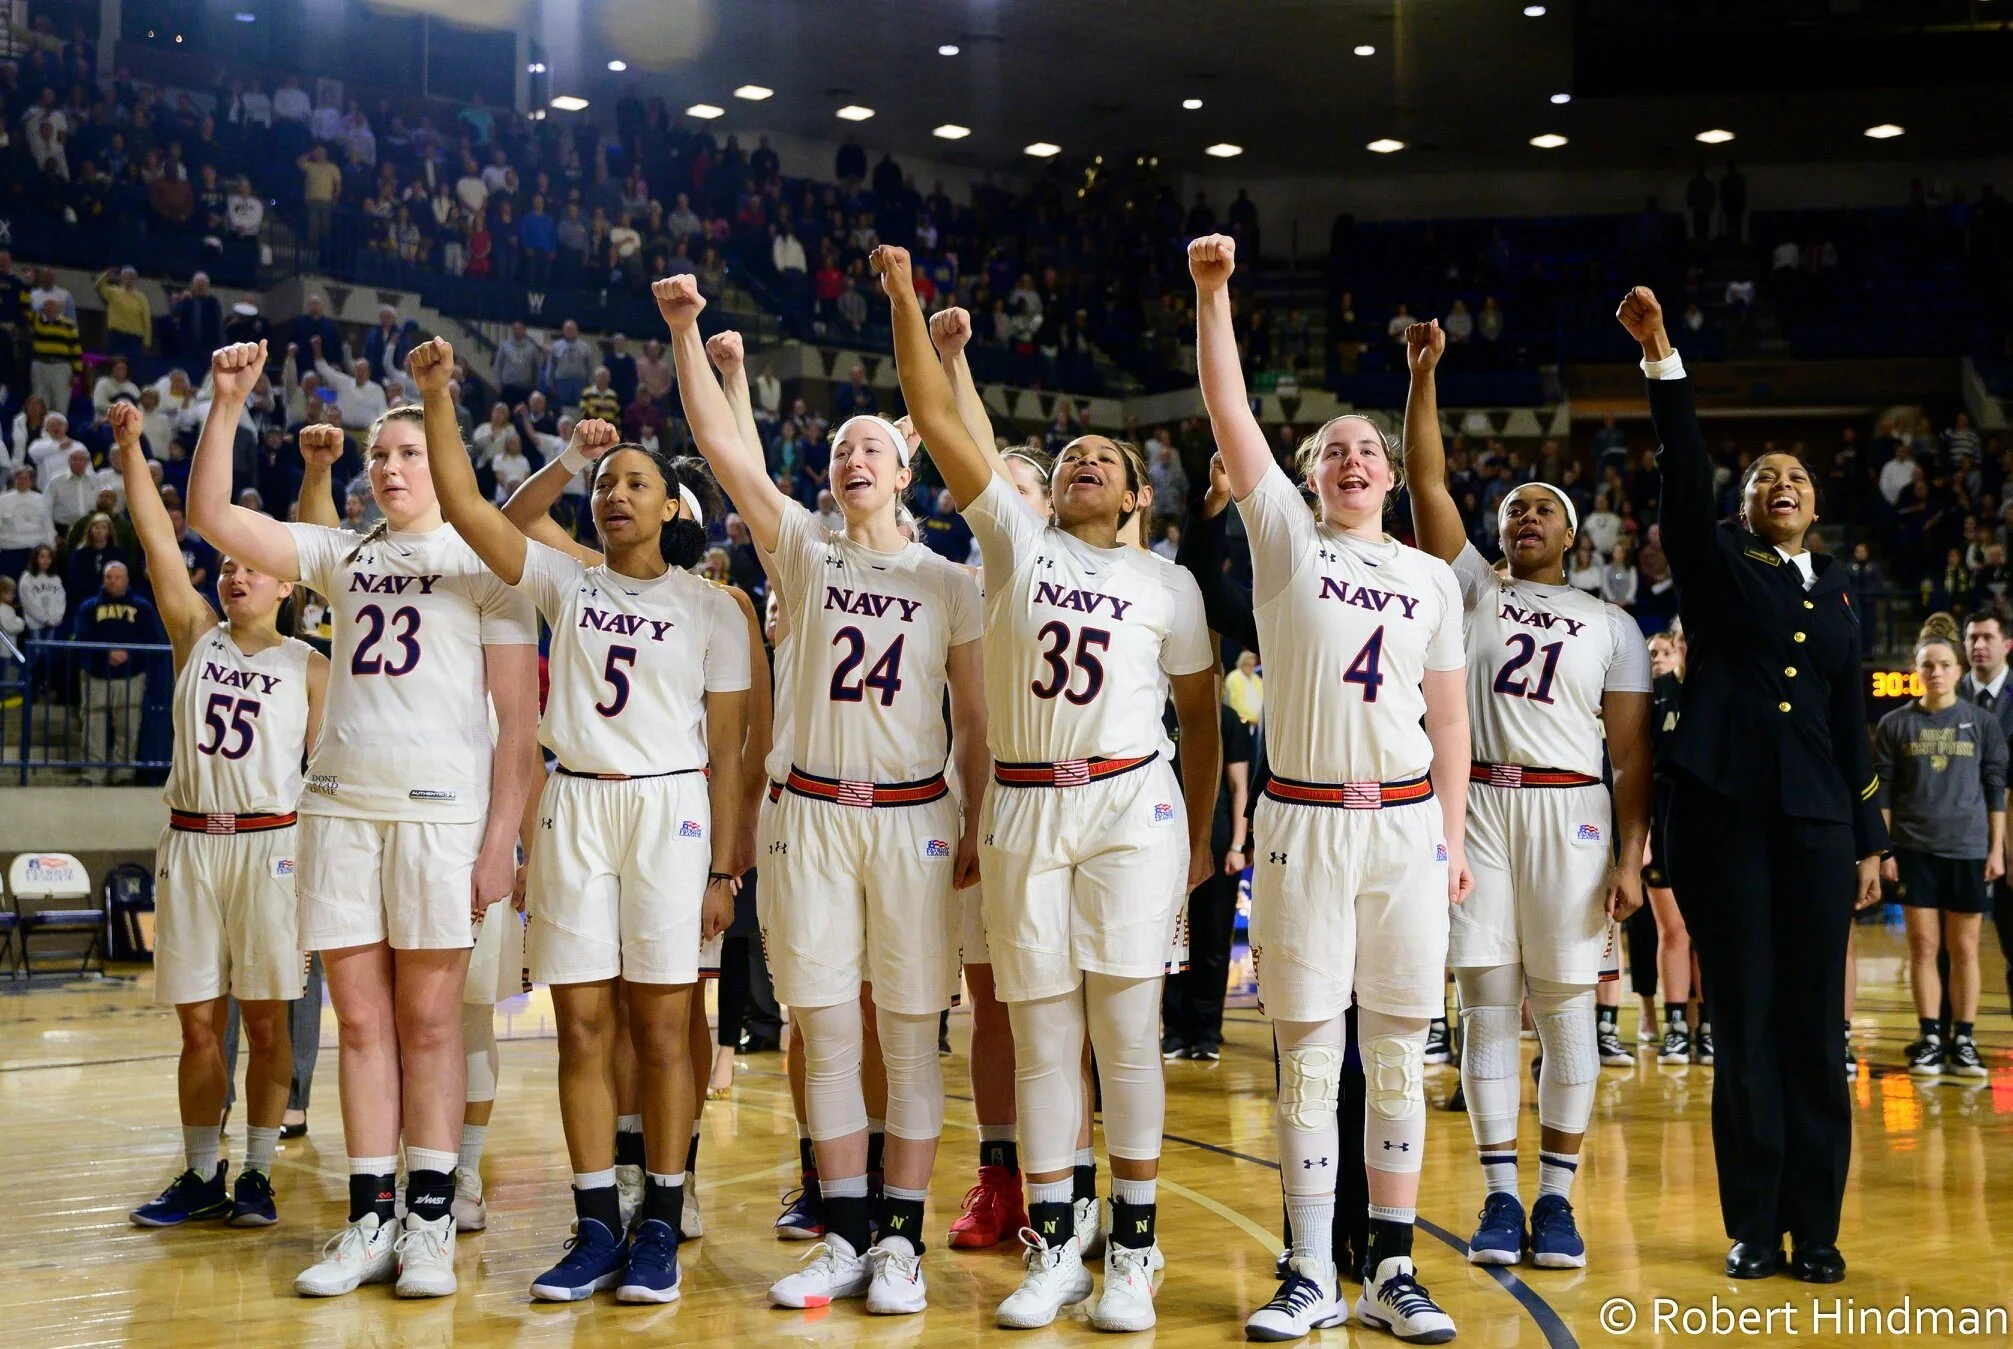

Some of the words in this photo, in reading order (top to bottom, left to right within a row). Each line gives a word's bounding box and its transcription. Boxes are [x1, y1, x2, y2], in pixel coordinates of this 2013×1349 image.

[348, 571, 443, 595] NAVY
[1032, 580, 1133, 621] NAVY
[1318, 576, 1420, 620] NAVY
[95, 604, 138, 623] NAVY
[823, 585, 922, 623] NAVY
[1498, 603, 1587, 637] NAVY
[351, 603, 422, 677] 23
[578, 606, 675, 642] NAVY
[202, 661, 282, 695] NAVY
[829, 625, 905, 707] 24
[1031, 620, 1111, 706] 35
[1342, 624, 1385, 703] 4
[1493, 632, 1564, 705] 21
[595, 644, 637, 718] 5
[197, 692, 261, 760] 55
[1919, 727, 1957, 742] ARMY
[1937, 741, 1975, 756] POINT
[312, 775, 338, 783] DONT
[414, 1193, 446, 1205] ZAMST
[889, 1214, 905, 1231] N
[1043, 1220, 1056, 1234] N
[1135, 1220, 1149, 1233] N
